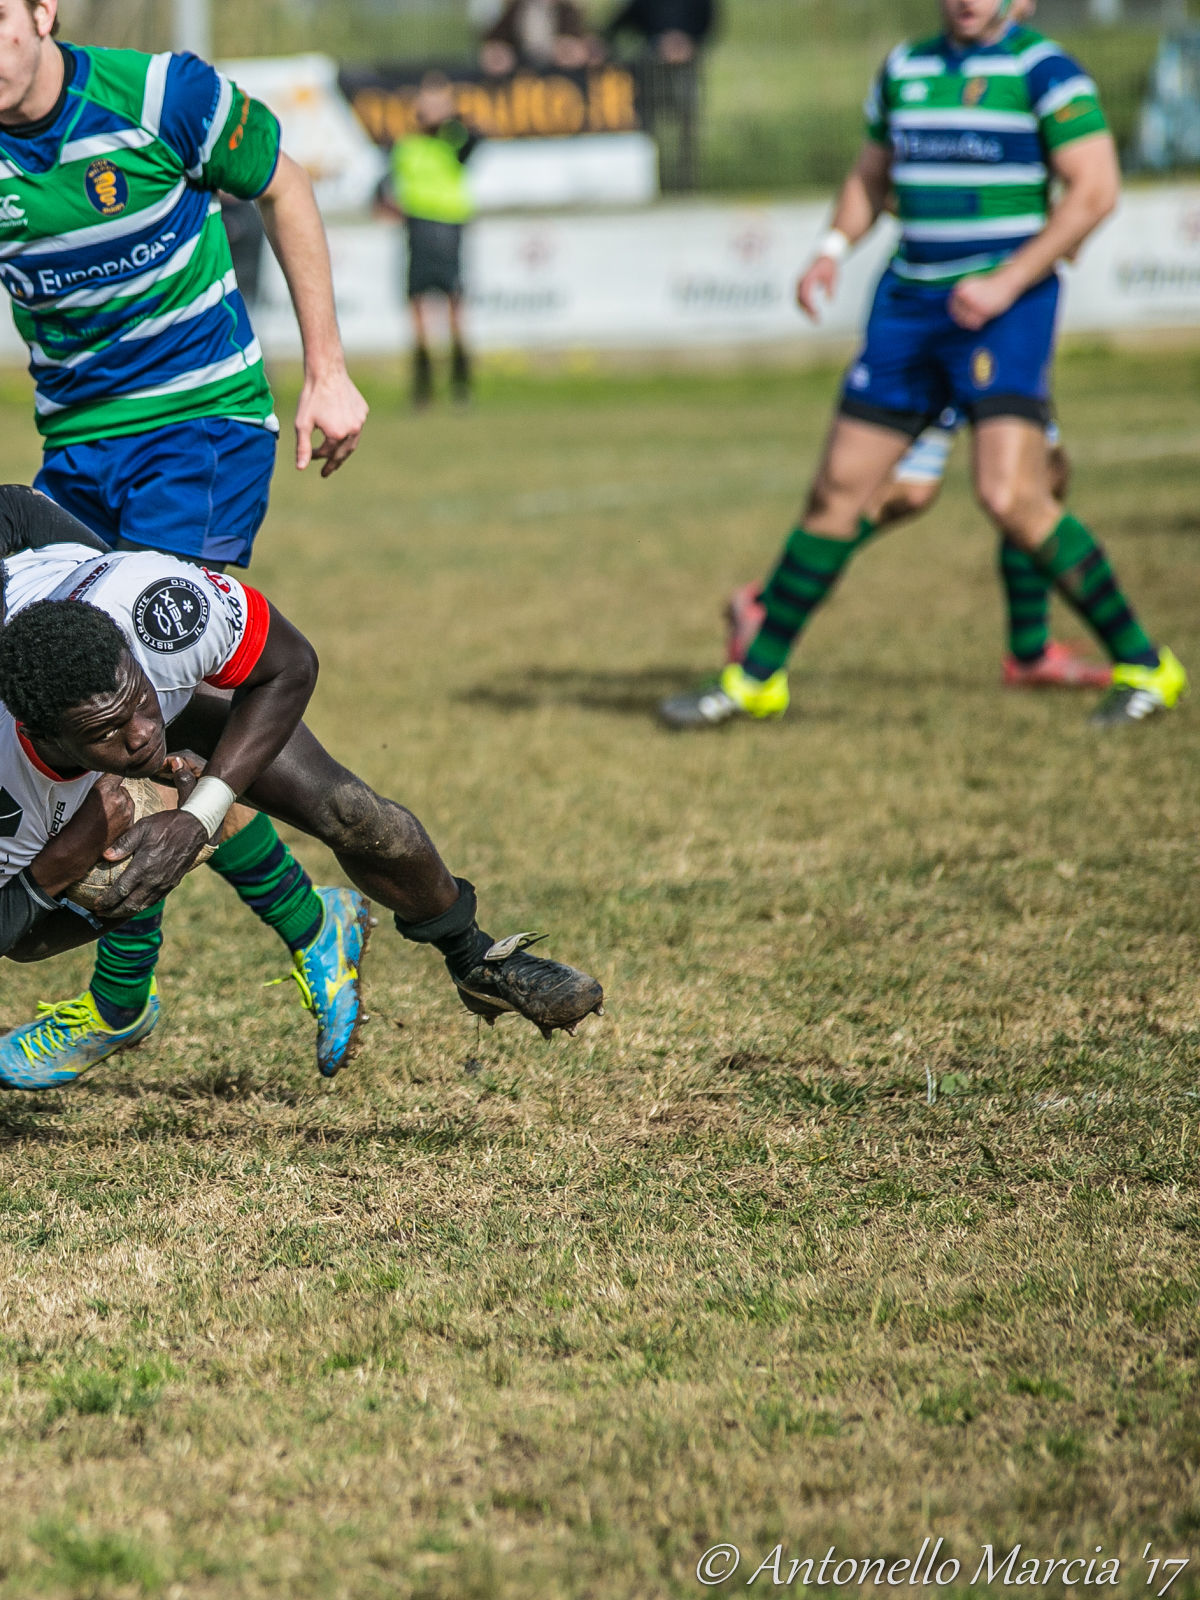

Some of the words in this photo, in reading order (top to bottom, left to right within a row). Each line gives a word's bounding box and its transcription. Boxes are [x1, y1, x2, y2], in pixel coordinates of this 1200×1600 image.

[136, 595, 174, 650] RISTORANTE
[159, 589, 188, 637] PEIX
[170, 579, 208, 624] SOPPALCO
[194, 626, 204, 637] IL
